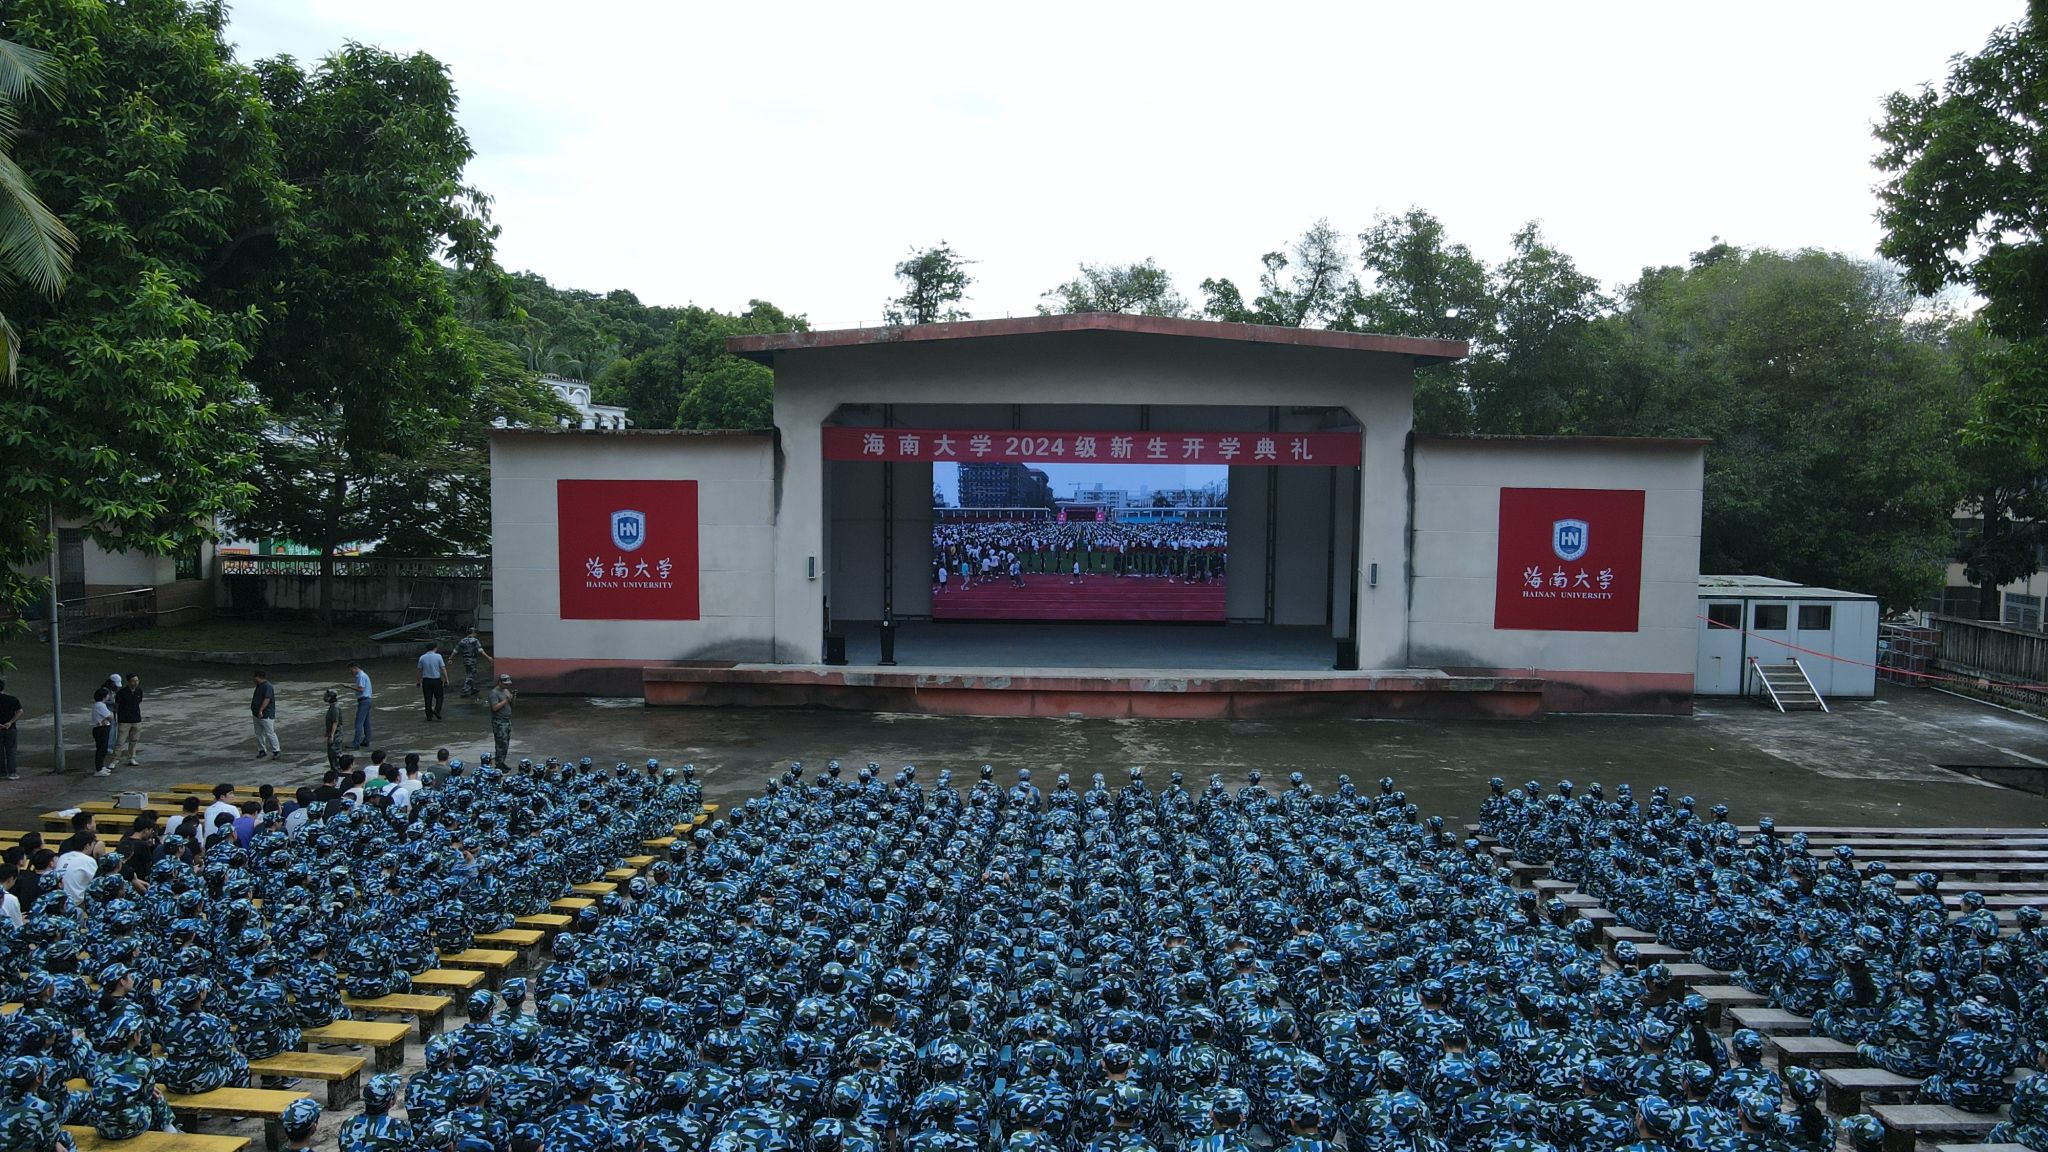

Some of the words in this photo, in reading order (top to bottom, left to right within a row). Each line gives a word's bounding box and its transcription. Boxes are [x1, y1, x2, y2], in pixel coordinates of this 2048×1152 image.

[862, 433, 1313, 460] 海南大学2024级新生开学典礼
[620, 522, 637, 537] HN
[1561, 531, 1579, 546] HN
[586, 556, 672, 579] 海南大学
[623, 581, 673, 589] UNIVERSITY
[1523, 565, 1614, 590] 海南大学
[1522, 590, 1556, 598] HAINAN
[1561, 591, 1613, 599] UNIVERSITY
